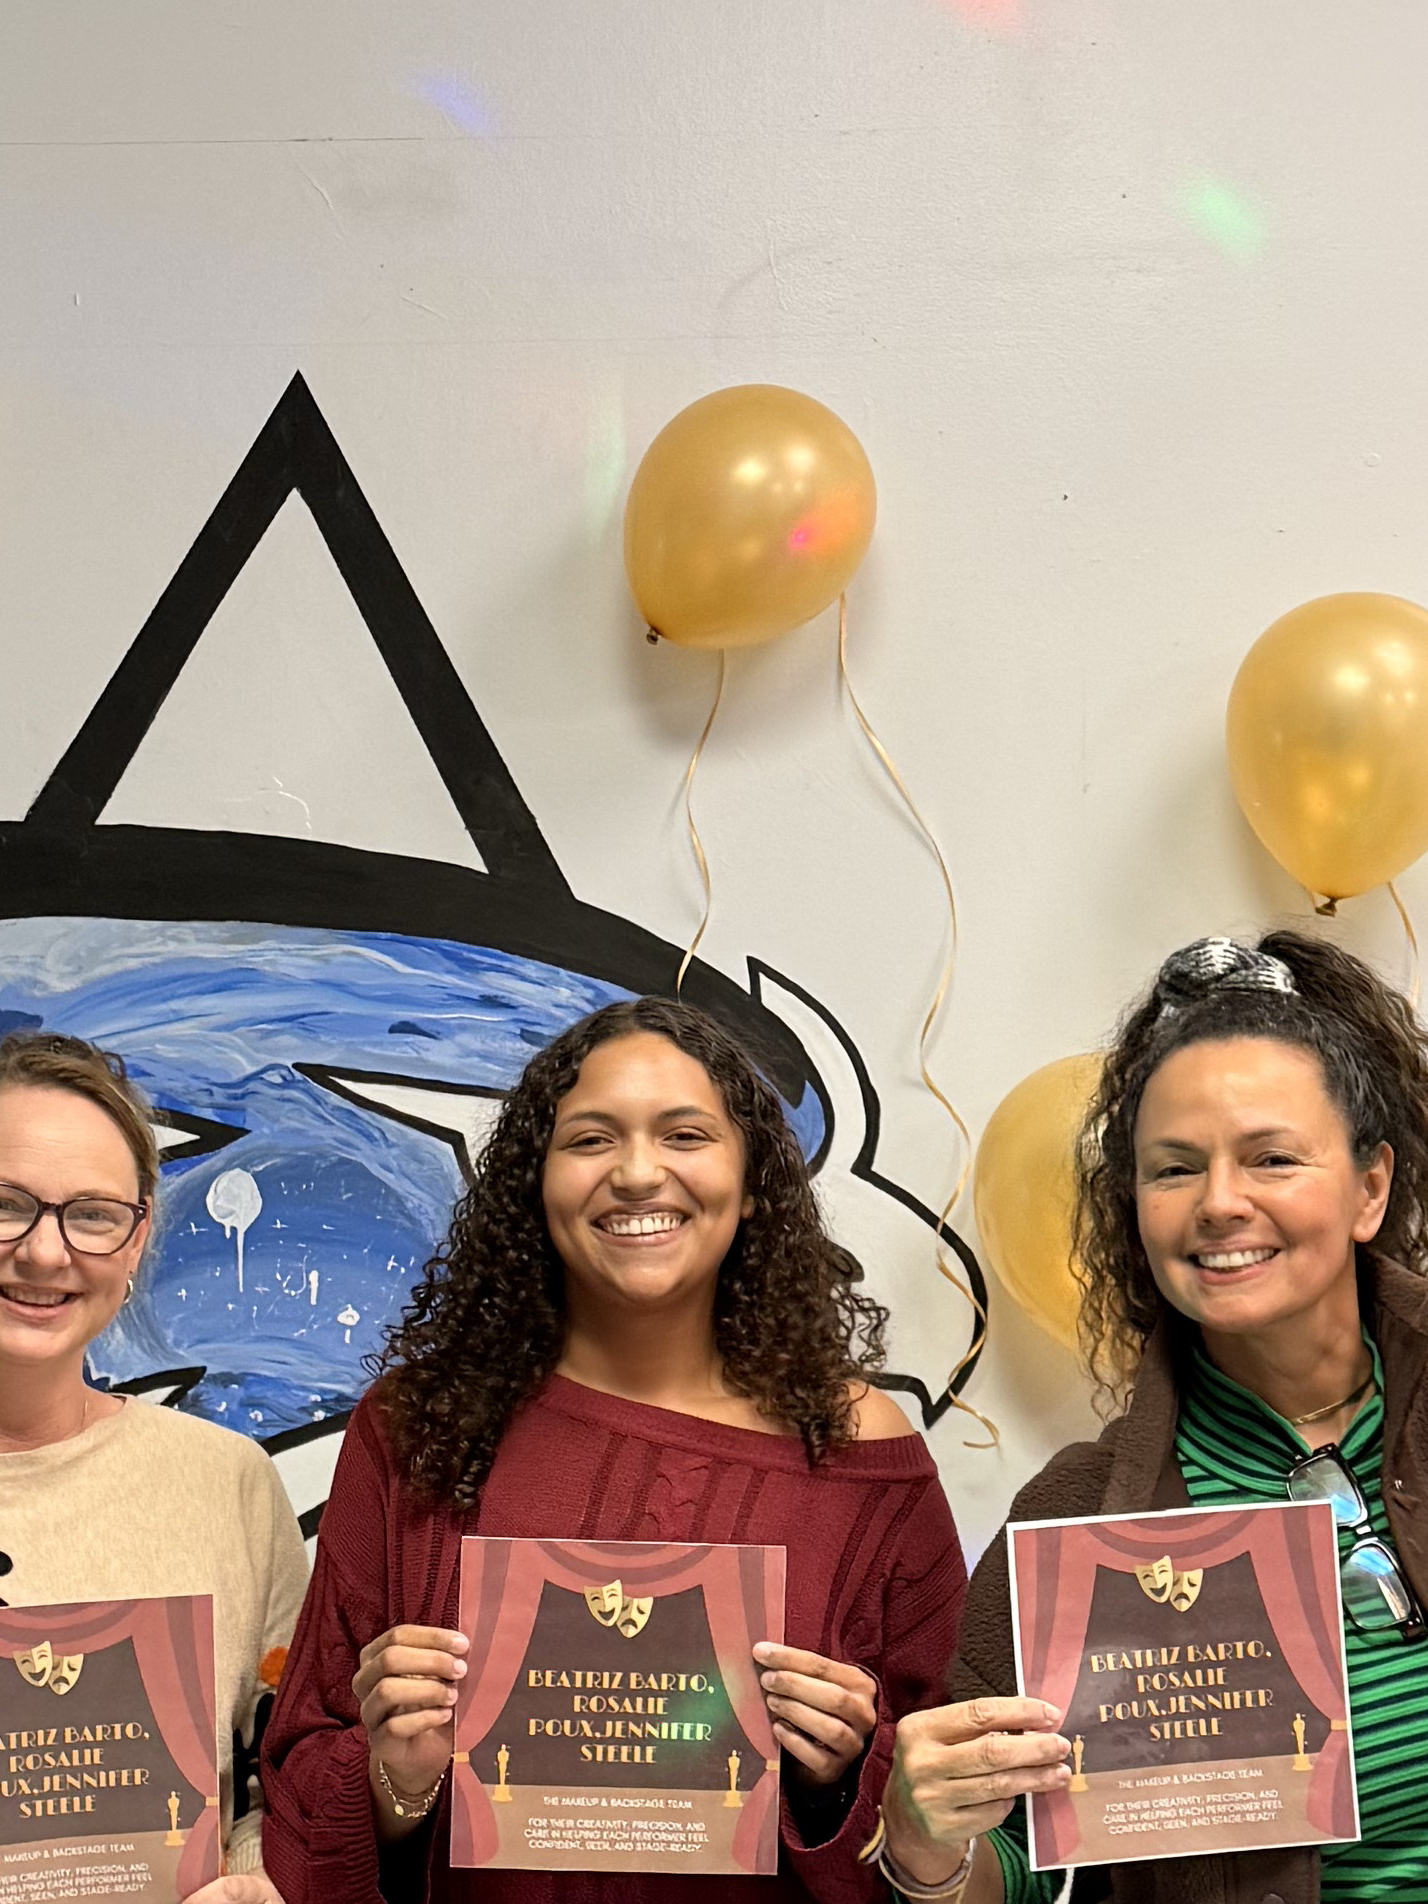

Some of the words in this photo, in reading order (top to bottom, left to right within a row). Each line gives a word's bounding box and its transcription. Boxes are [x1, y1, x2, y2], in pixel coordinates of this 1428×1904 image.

[1090, 1646, 1181, 1672] BEATRIZ
[528, 1669, 623, 1689] BEATRIZ
[629, 1672, 714, 1694] BARTO,
[1136, 1667, 1227, 1693] ROSALIE
[573, 1695, 668, 1714] ROSALIE
[64, 1722, 149, 1744] BARTO,
[1149, 1717, 1223, 1741] STEELE
[9, 1748, 104, 1772] ROSALIE
[580, 1743, 657, 1763] STEELE
[19, 1794, 96, 1818] STEELE
